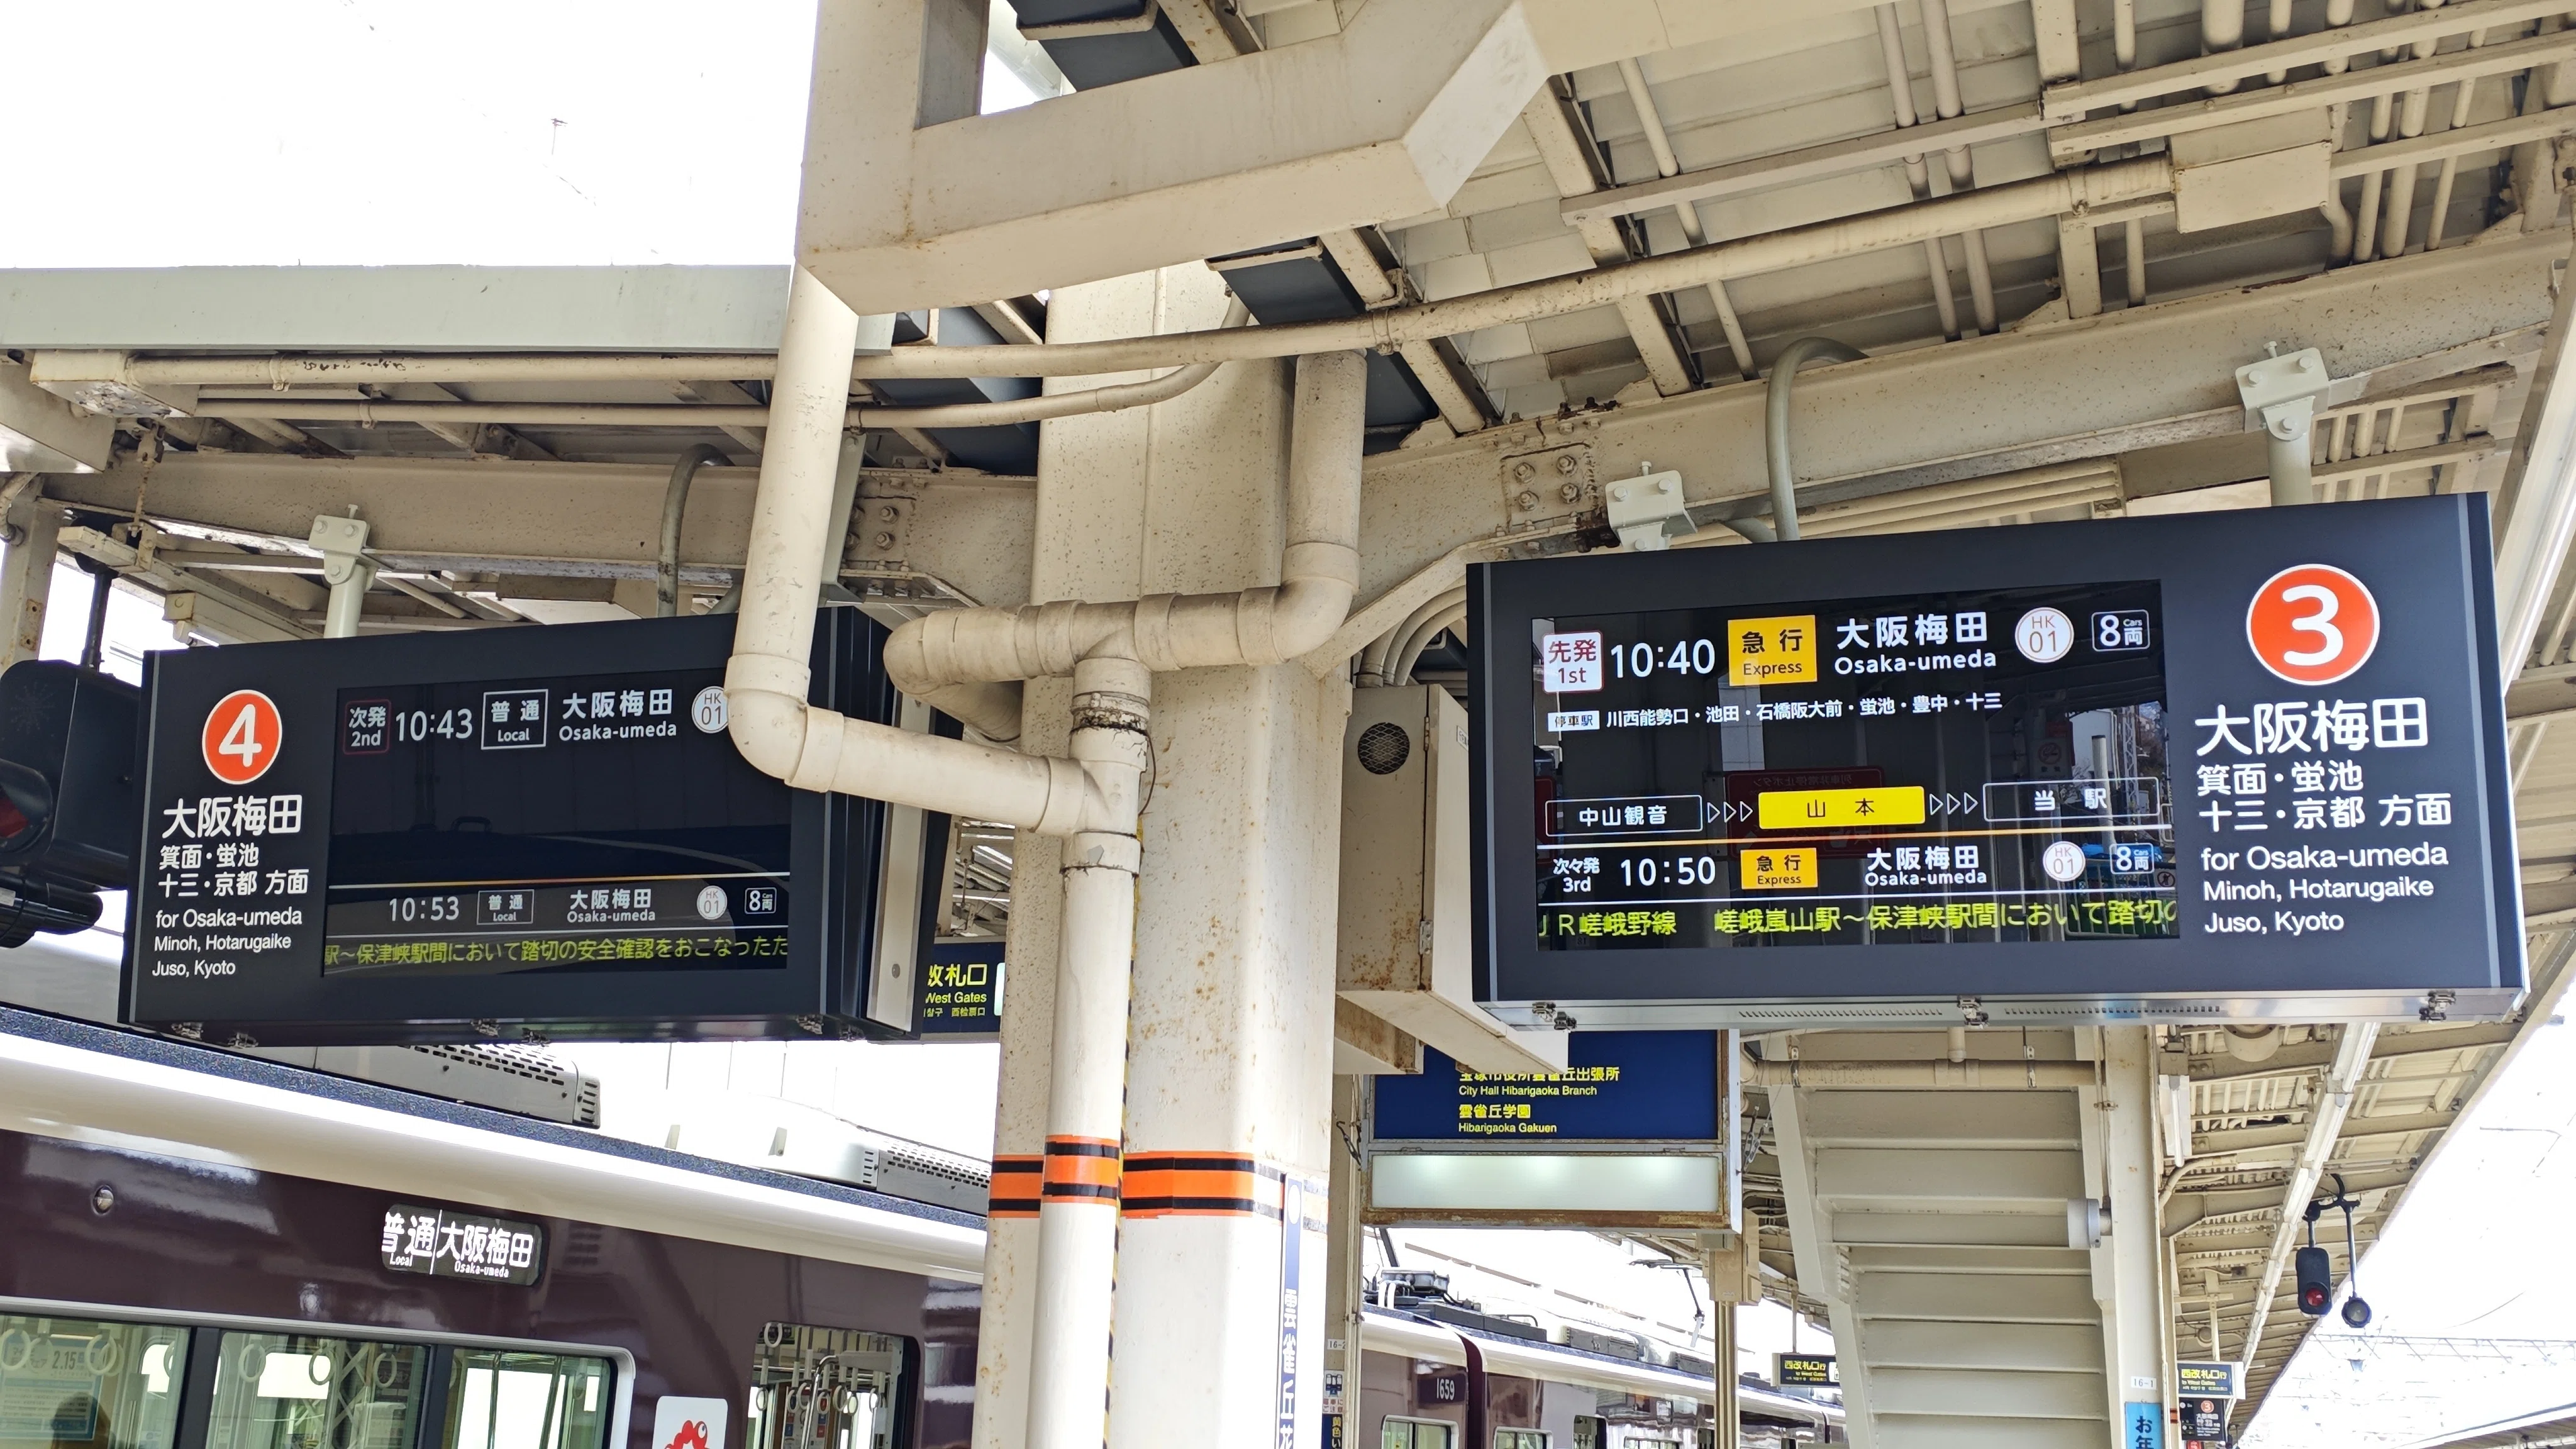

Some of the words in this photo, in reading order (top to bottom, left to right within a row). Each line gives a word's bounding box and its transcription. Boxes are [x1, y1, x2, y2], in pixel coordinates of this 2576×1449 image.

[1836, 611, 1987, 650] 大阪梅田
[2031, 614, 2056, 629] HK
[2123, 618, 2143, 627] Cars
[2282, 584, 2344, 666] 3
[1548, 638, 1597, 663] 先発
[1741, 629, 1804, 654] 急行
[2029, 631, 2057, 653] 01
[1610, 638, 1716, 679] 10:40
[1743, 662, 1802, 677] Express
[1834, 649, 1997, 675] Osaka-umeda
[1558, 666, 1587, 684] 1st
[562, 689, 672, 720] 大阪梅田
[704, 692, 722, 705] HK
[348, 705, 386, 728] 次発
[491, 699, 541, 723] 普通
[701, 705, 721, 725] 01
[1555, 714, 1593, 728] 停車駅
[218, 703, 263, 768] 4
[395, 708, 474, 742] 10:43
[497, 728, 531, 743] Local
[558, 720, 677, 742] Osaka-umeda
[2194, 697, 2429, 757] 大阪梅田
[351, 730, 382, 748] 2nd
[2197, 759, 2364, 797] 箕面・蛍池
[1807, 797, 1875, 818] 山本
[2033, 787, 2108, 812] 当駅
[162, 794, 303, 840] 大阪梅田
[1579, 805, 1668, 827] 中山観音
[2199, 796, 2365, 833] 十三・京都
[2379, 792, 2451, 827] 方面
[159, 843, 260, 870] 箕面・蛍池
[1867, 845, 1979, 872] 大阪梅田
[2055, 847, 2073, 857] HK
[2201, 847, 2239, 871] for
[2248, 841, 2449, 869] Osaka-umeda
[1553, 857, 1601, 875] 次々発
[1620, 856, 1716, 887] 10:50
[1756, 855, 1802, 872] 急行
[2053, 858, 2074, 875] 01
[158, 870, 258, 899] 十三・京都
[265, 868, 309, 896] 方面
[1563, 876, 1591, 893] 3rd
[1757, 874, 1802, 887] Express
[1865, 869, 1987, 887] Osaka-umeda
[2204, 879, 2282, 902] Minoh,
[2289, 875, 2434, 902] Hotarugaike
[487, 894, 524, 911] 普通
[570, 888, 652, 911] 大阪梅田
[706, 891, 718, 899] HK
[155, 909, 179, 928] for
[182, 906, 303, 928] Osaka-umeda
[389, 896, 460, 922] 10:53
[492, 910, 517, 923] Local
[567, 909, 656, 923] Osaka-umeda
[704, 900, 719, 914] 01
[2204, 911, 2267, 935] Juso,
[2275, 910, 2345, 935] Kyoto
[154, 935, 202, 953] Minoh,
[205, 933, 292, 953] Hotarugaike
[152, 960, 190, 979] Juso,
[194, 958, 236, 978] Kyoto
[954, 991, 987, 1003] Gates
[1458, 1085, 1478, 1097] City
[1480, 1085, 1499, 1096] Hall
[1502, 1085, 1560, 1098] Hibarigaoka
[1562, 1085, 1597, 1096] Branch
[1458, 1103, 1531, 1119] 雲雀丘学園
[1458, 1122, 1516, 1135] Hibarigaoka
[1518, 1123, 1557, 1133] Gakuen
[381, 1211, 436, 1258] 普通
[436, 1221, 534, 1268] 大阪梅田
[389, 1252, 413, 1267] Local
[454, 1260, 509, 1279] Osaka-umeda
[1436, 1378, 1455, 1401] 1659
[2133, 1379, 2154, 1388] 16-1
